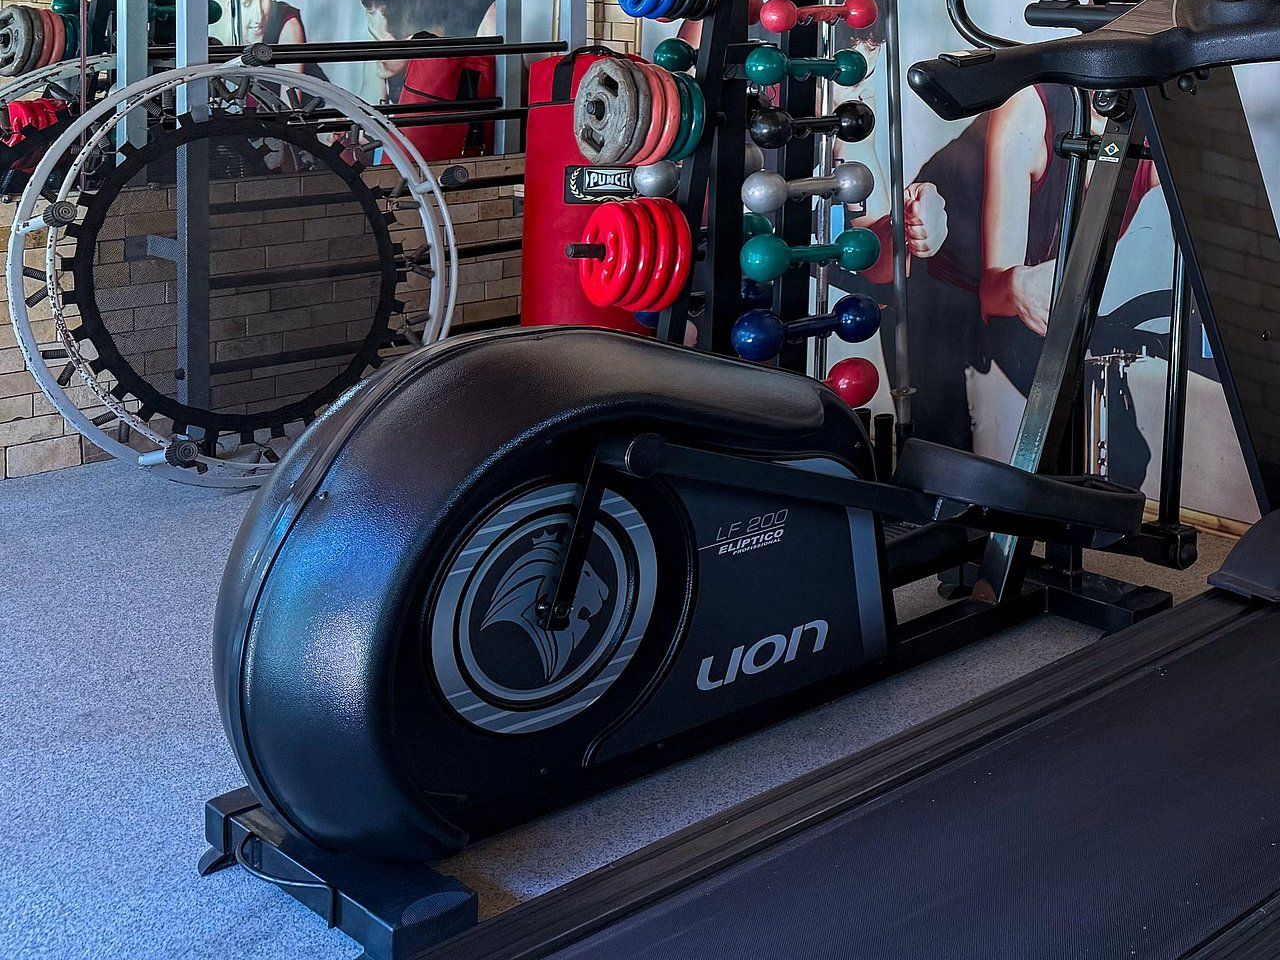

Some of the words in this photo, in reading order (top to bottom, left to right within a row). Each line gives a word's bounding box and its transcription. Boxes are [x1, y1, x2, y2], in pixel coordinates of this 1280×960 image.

[589, 172, 629, 188] PUNCH
[716, 521, 742, 542] LF
[746, 508, 789, 533] 200
[718, 528, 785, 555] ELÍPTICO
[732, 537, 782, 556] PROFISSIONAL
[696, 619, 829, 691] LION
